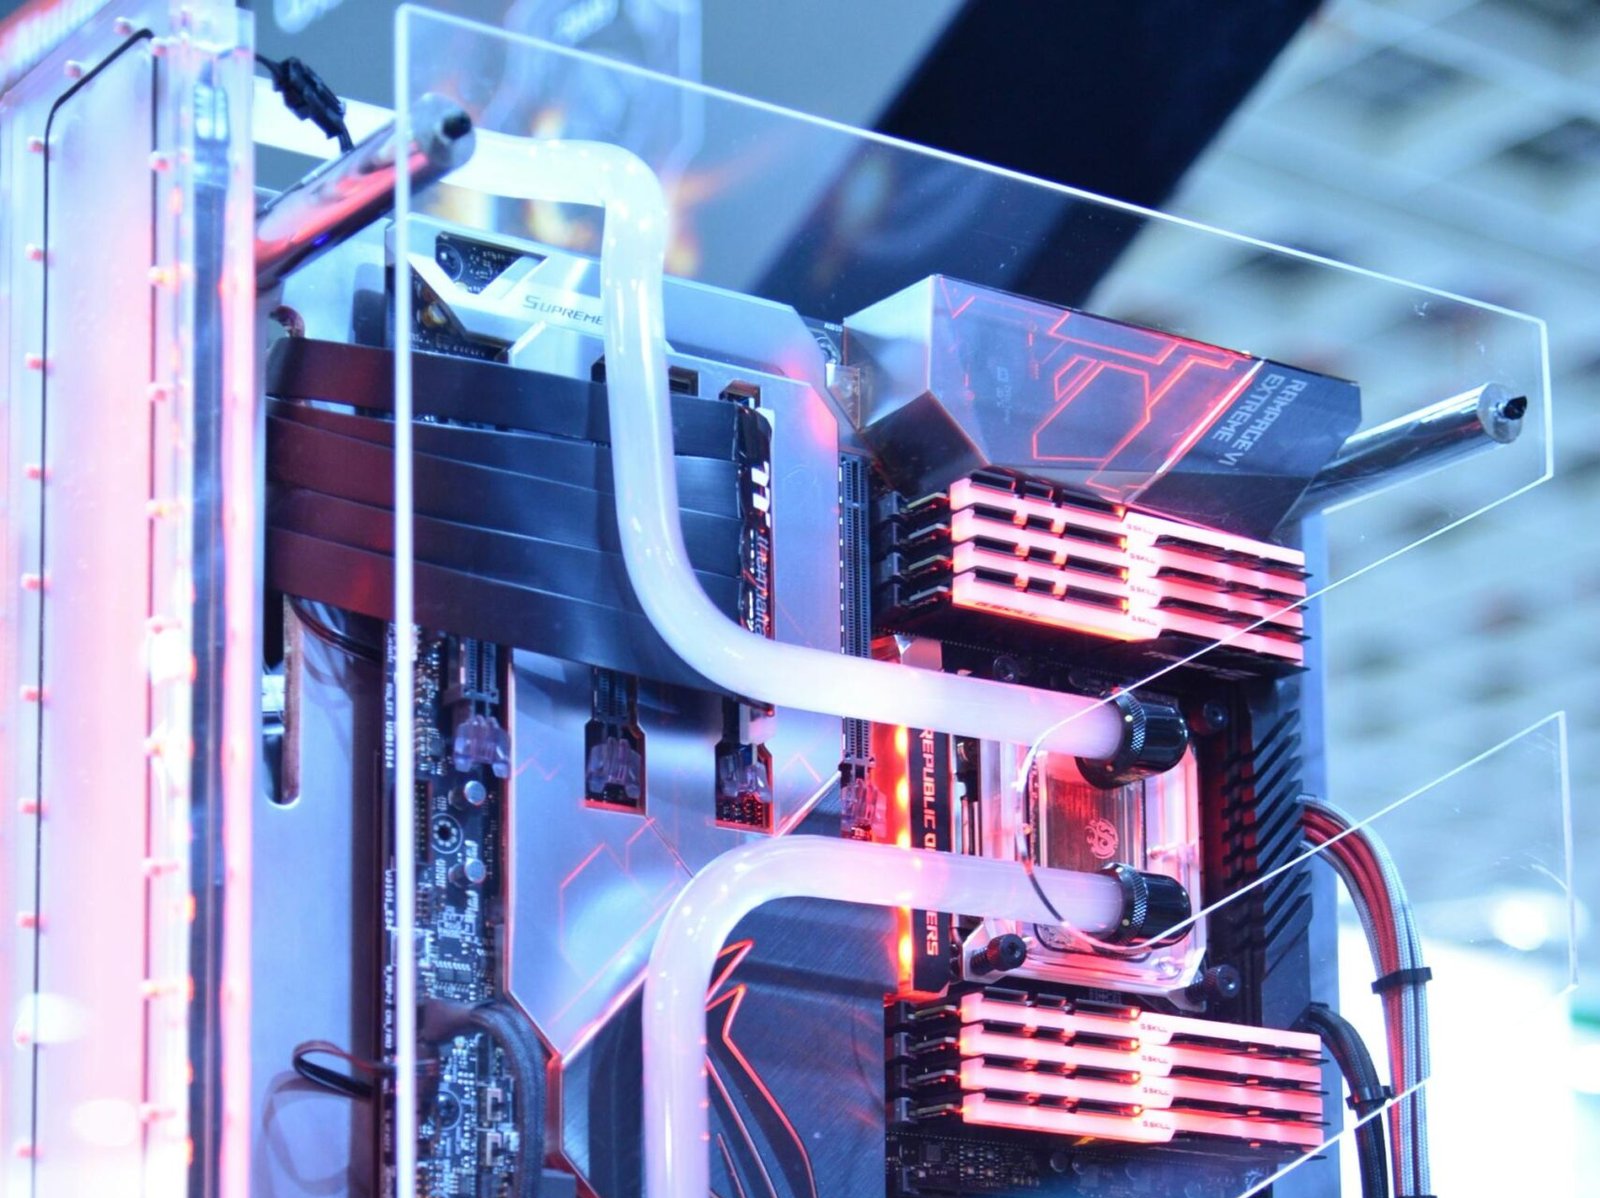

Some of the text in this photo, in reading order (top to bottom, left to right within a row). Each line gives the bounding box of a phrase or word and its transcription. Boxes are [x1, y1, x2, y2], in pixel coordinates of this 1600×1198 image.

[1212, 374, 1285, 442] EXTREME
[1218, 379, 1307, 466] RAMPAGE VI
[920, 729, 936, 829] REPUBLIC
[924, 833, 937, 852] O
